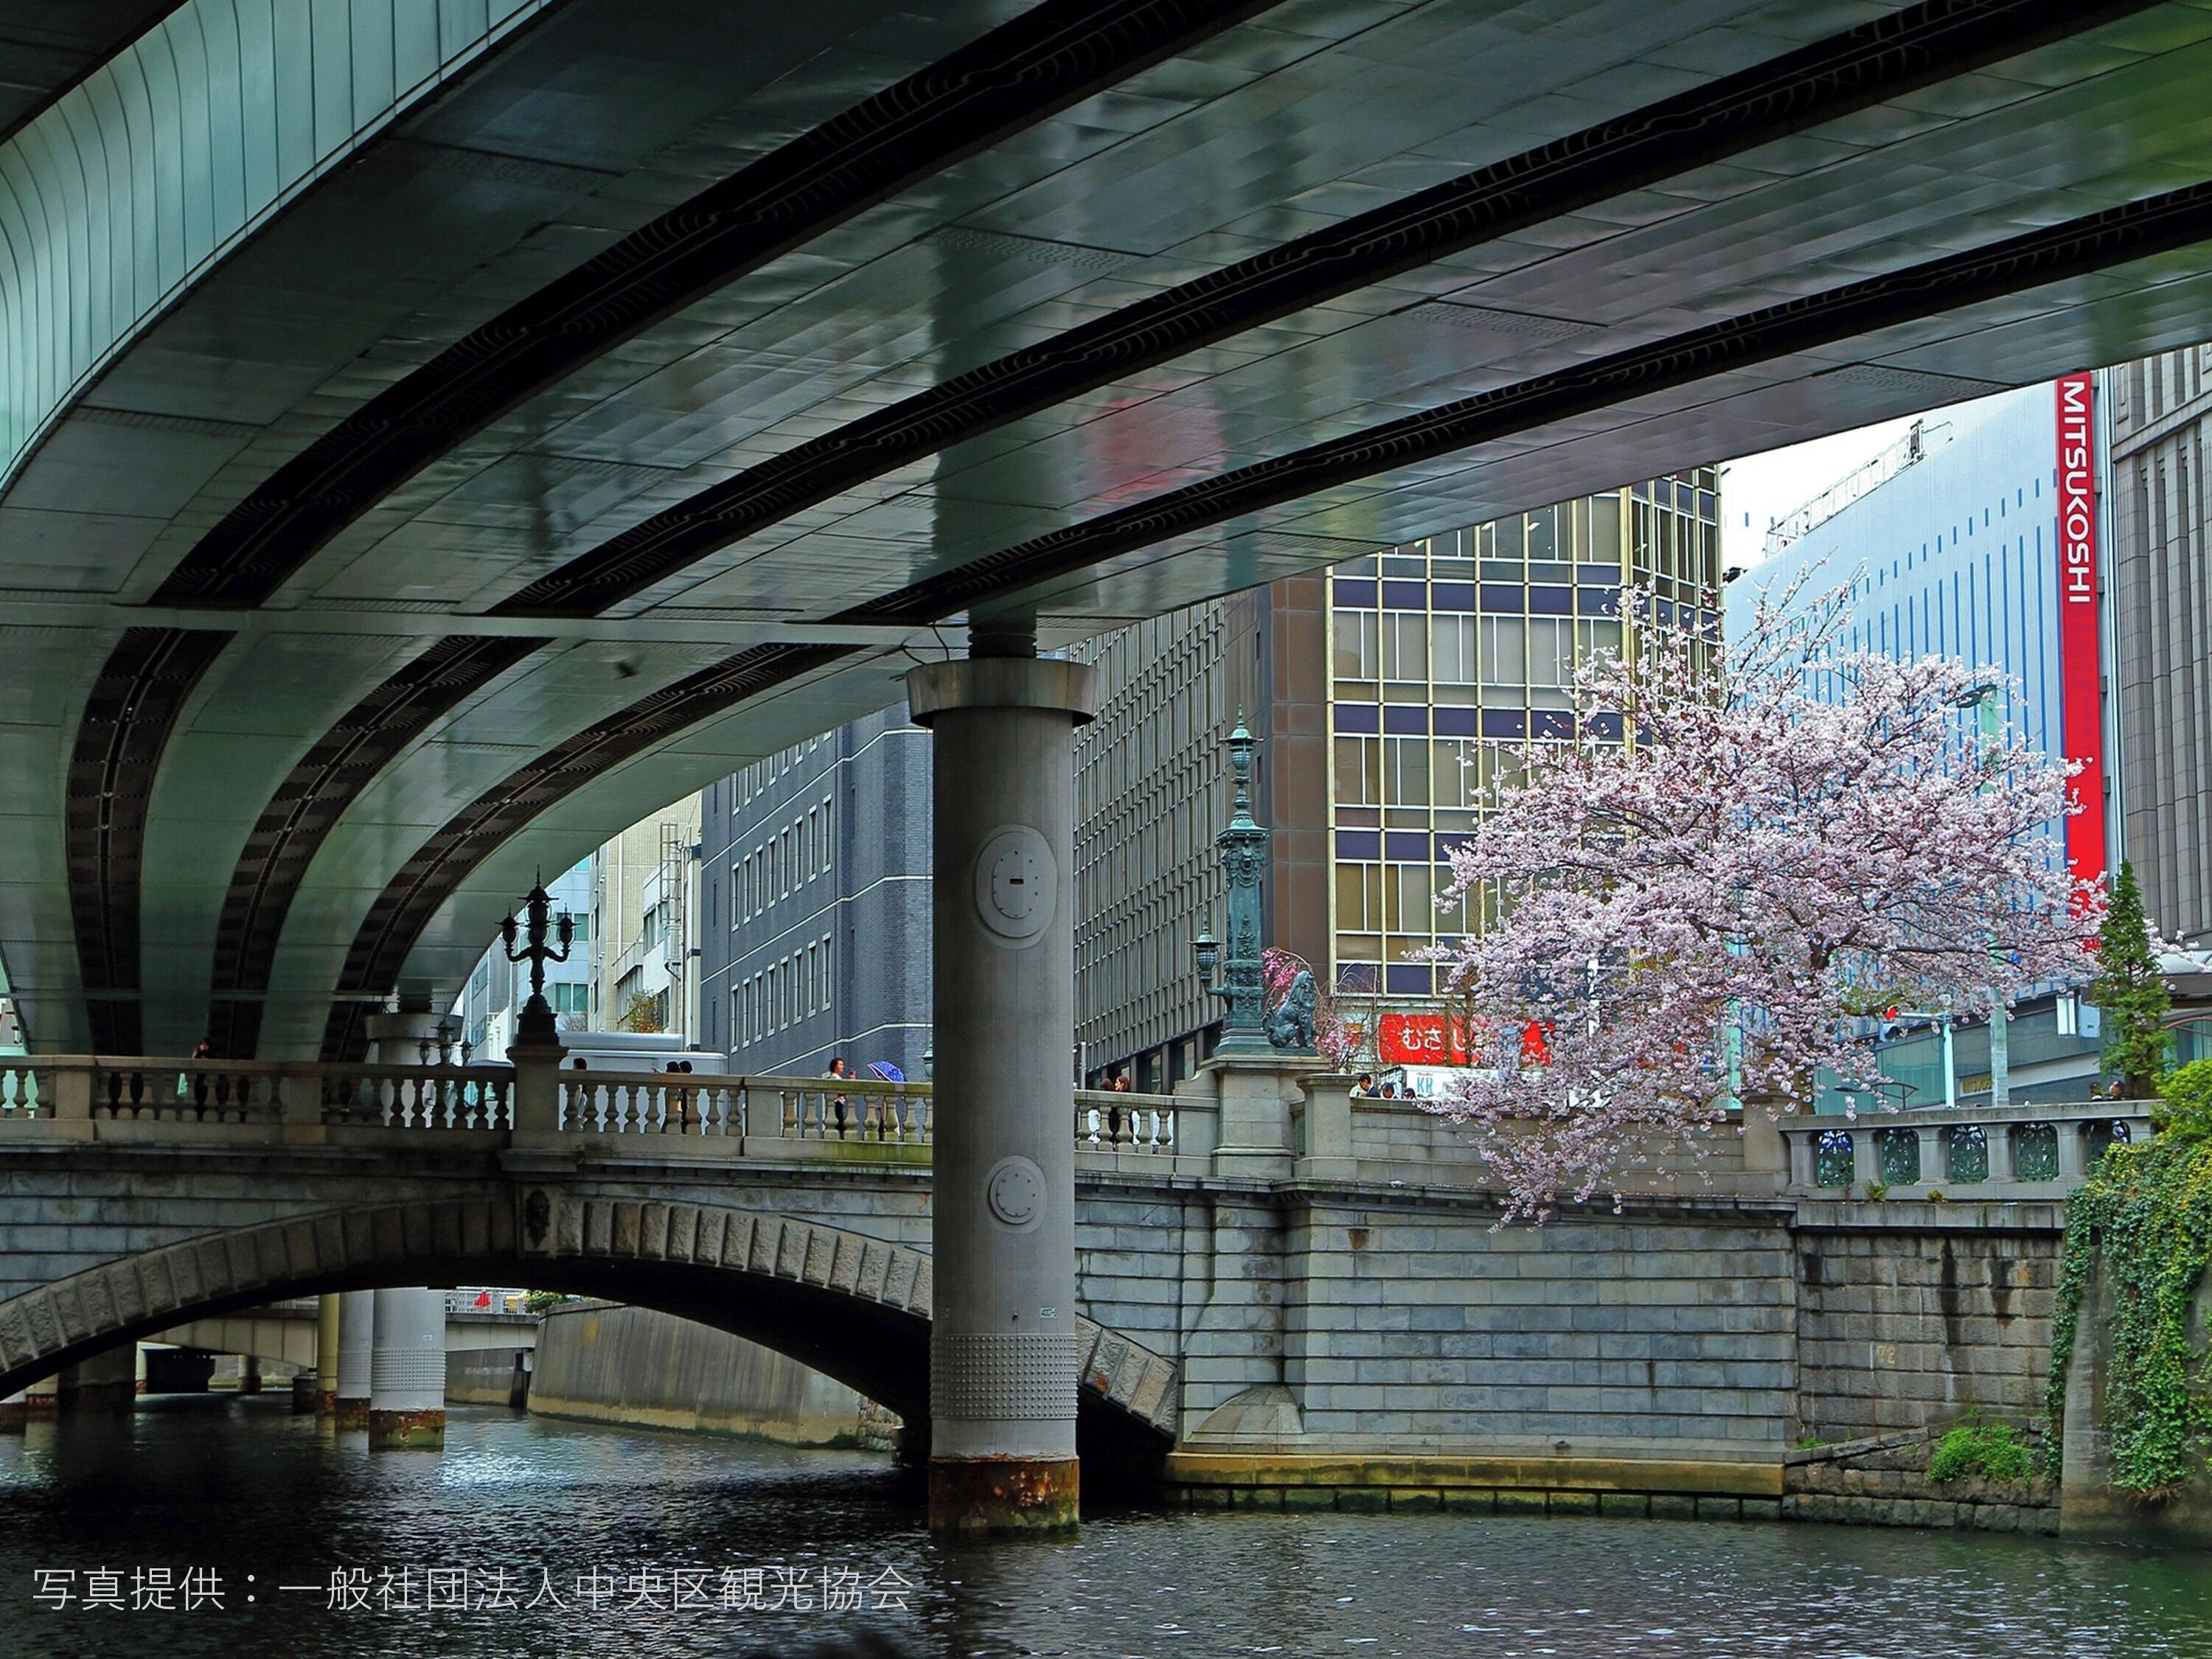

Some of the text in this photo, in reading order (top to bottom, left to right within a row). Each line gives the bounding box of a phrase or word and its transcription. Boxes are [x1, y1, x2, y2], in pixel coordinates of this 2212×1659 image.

[2063, 381, 2091, 603] MITSUKOSHI
[1402, 1027, 1466, 1051] むさし
